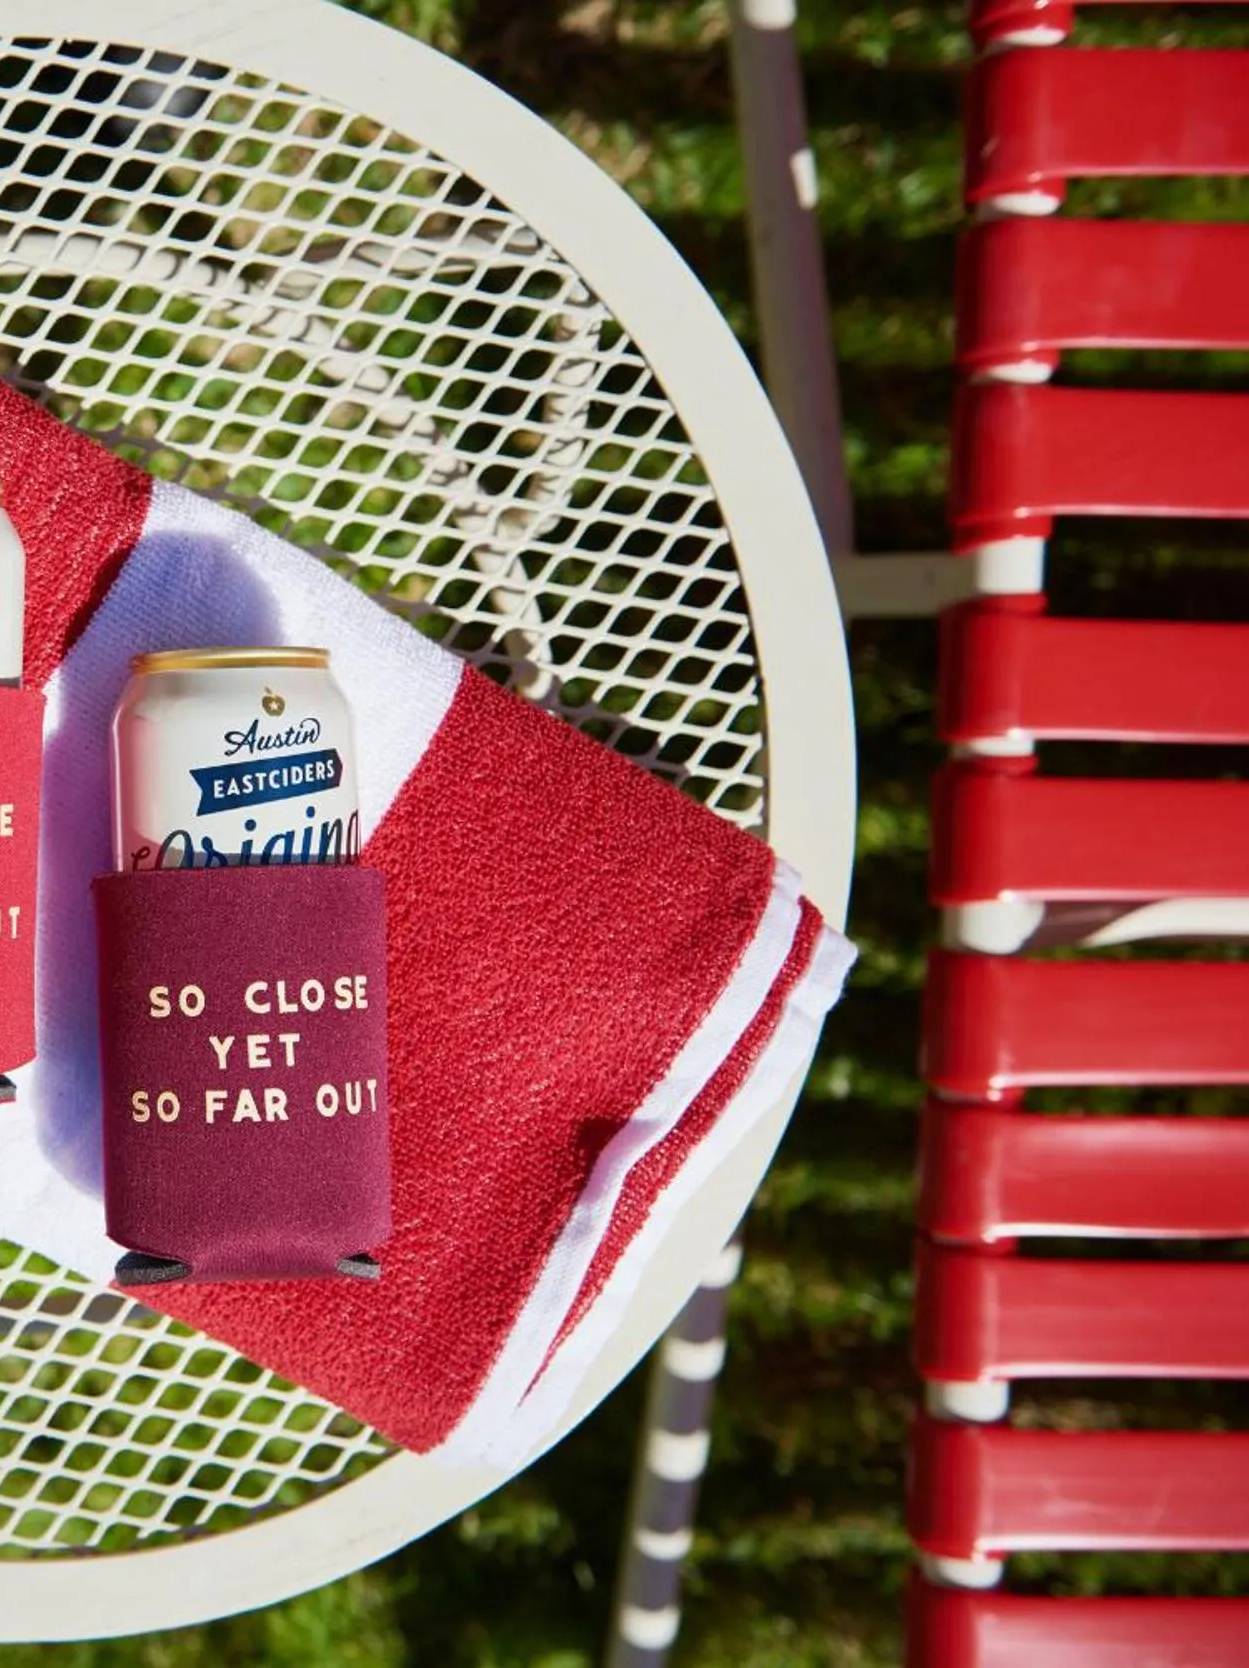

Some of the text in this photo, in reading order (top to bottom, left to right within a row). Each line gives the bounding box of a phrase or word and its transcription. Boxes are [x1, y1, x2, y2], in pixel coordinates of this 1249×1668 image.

[223, 717, 321, 757] Austin
[213, 759, 335, 799] EASTCIDERS
[149, 975, 369, 1018] SO CLOSE
[209, 1033, 301, 1070] YET
[131, 1079, 378, 1124] SO FAR OUT
